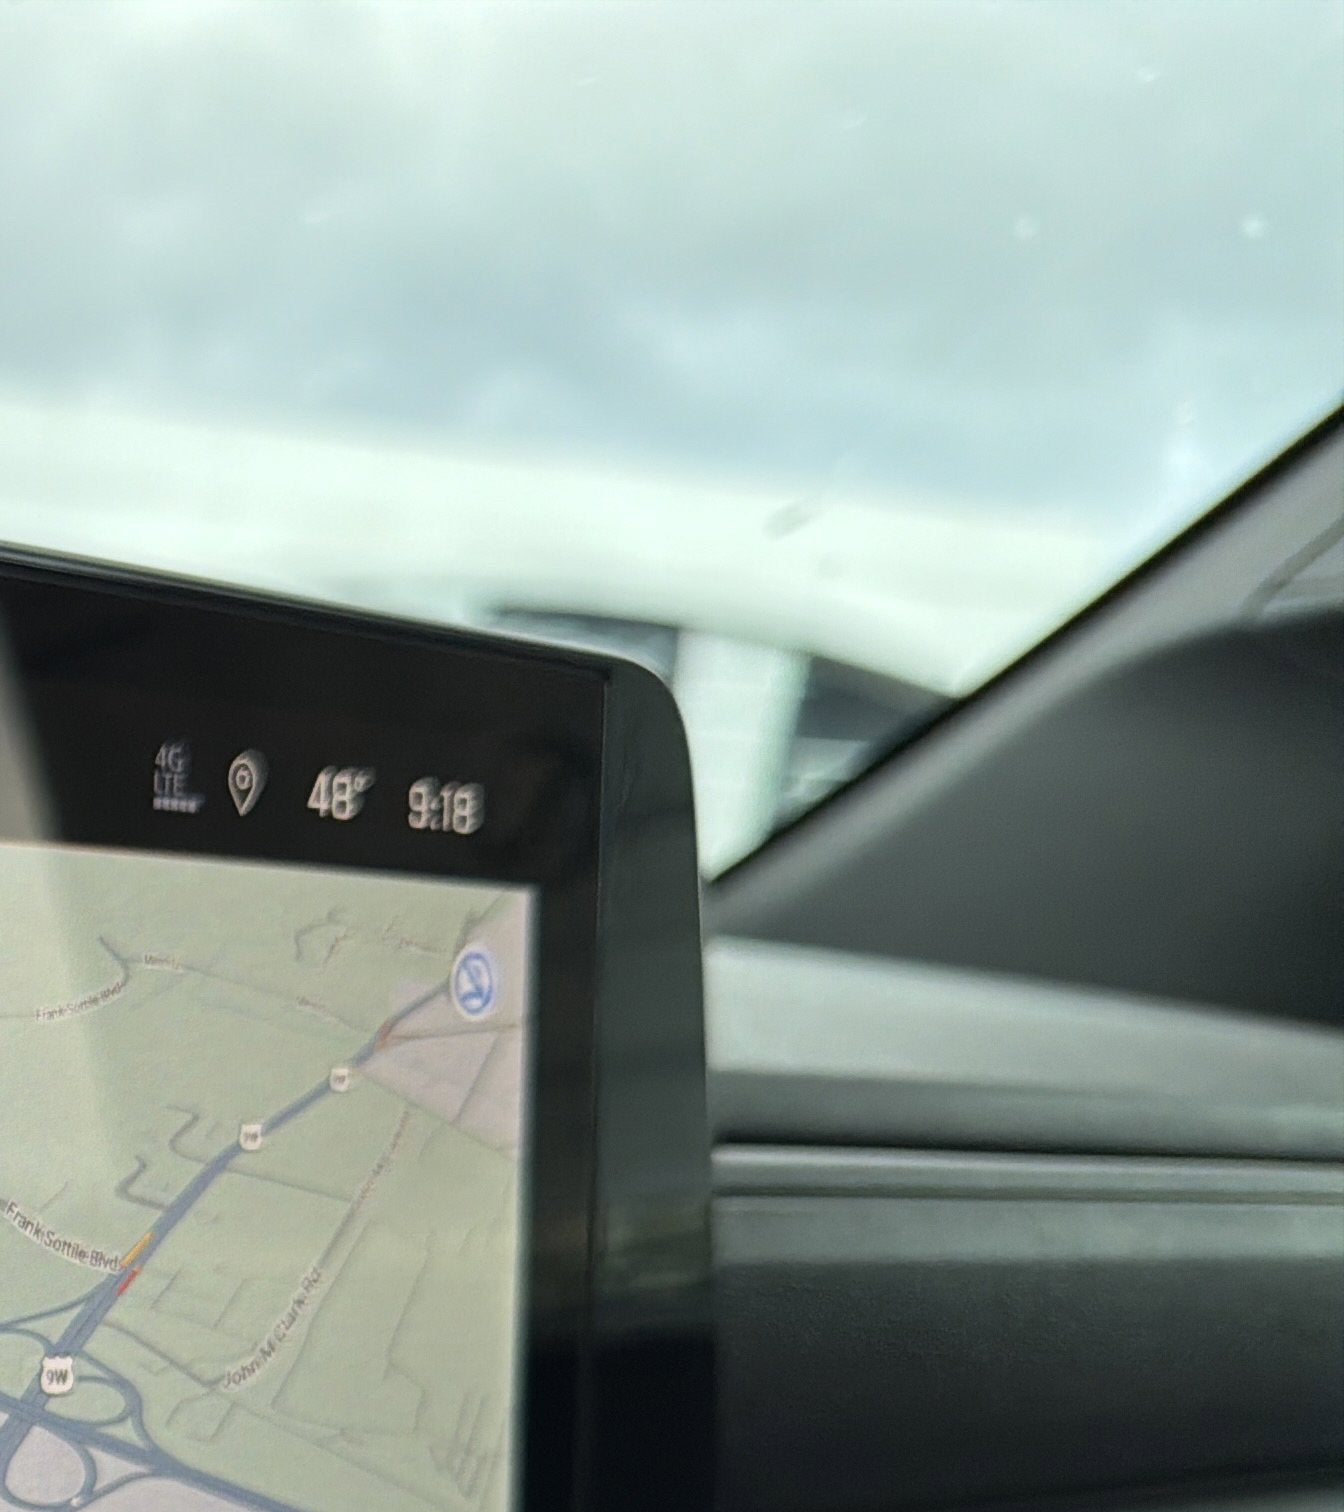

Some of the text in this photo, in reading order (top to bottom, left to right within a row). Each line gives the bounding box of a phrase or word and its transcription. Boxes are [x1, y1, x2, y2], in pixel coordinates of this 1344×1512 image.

[154, 744, 184, 772] 4G
[408, 777, 484, 835] 9:18
[5, 1201, 119, 1272] Frank Sottile Blvd
[46, 1367, 69, 1386] 9W
